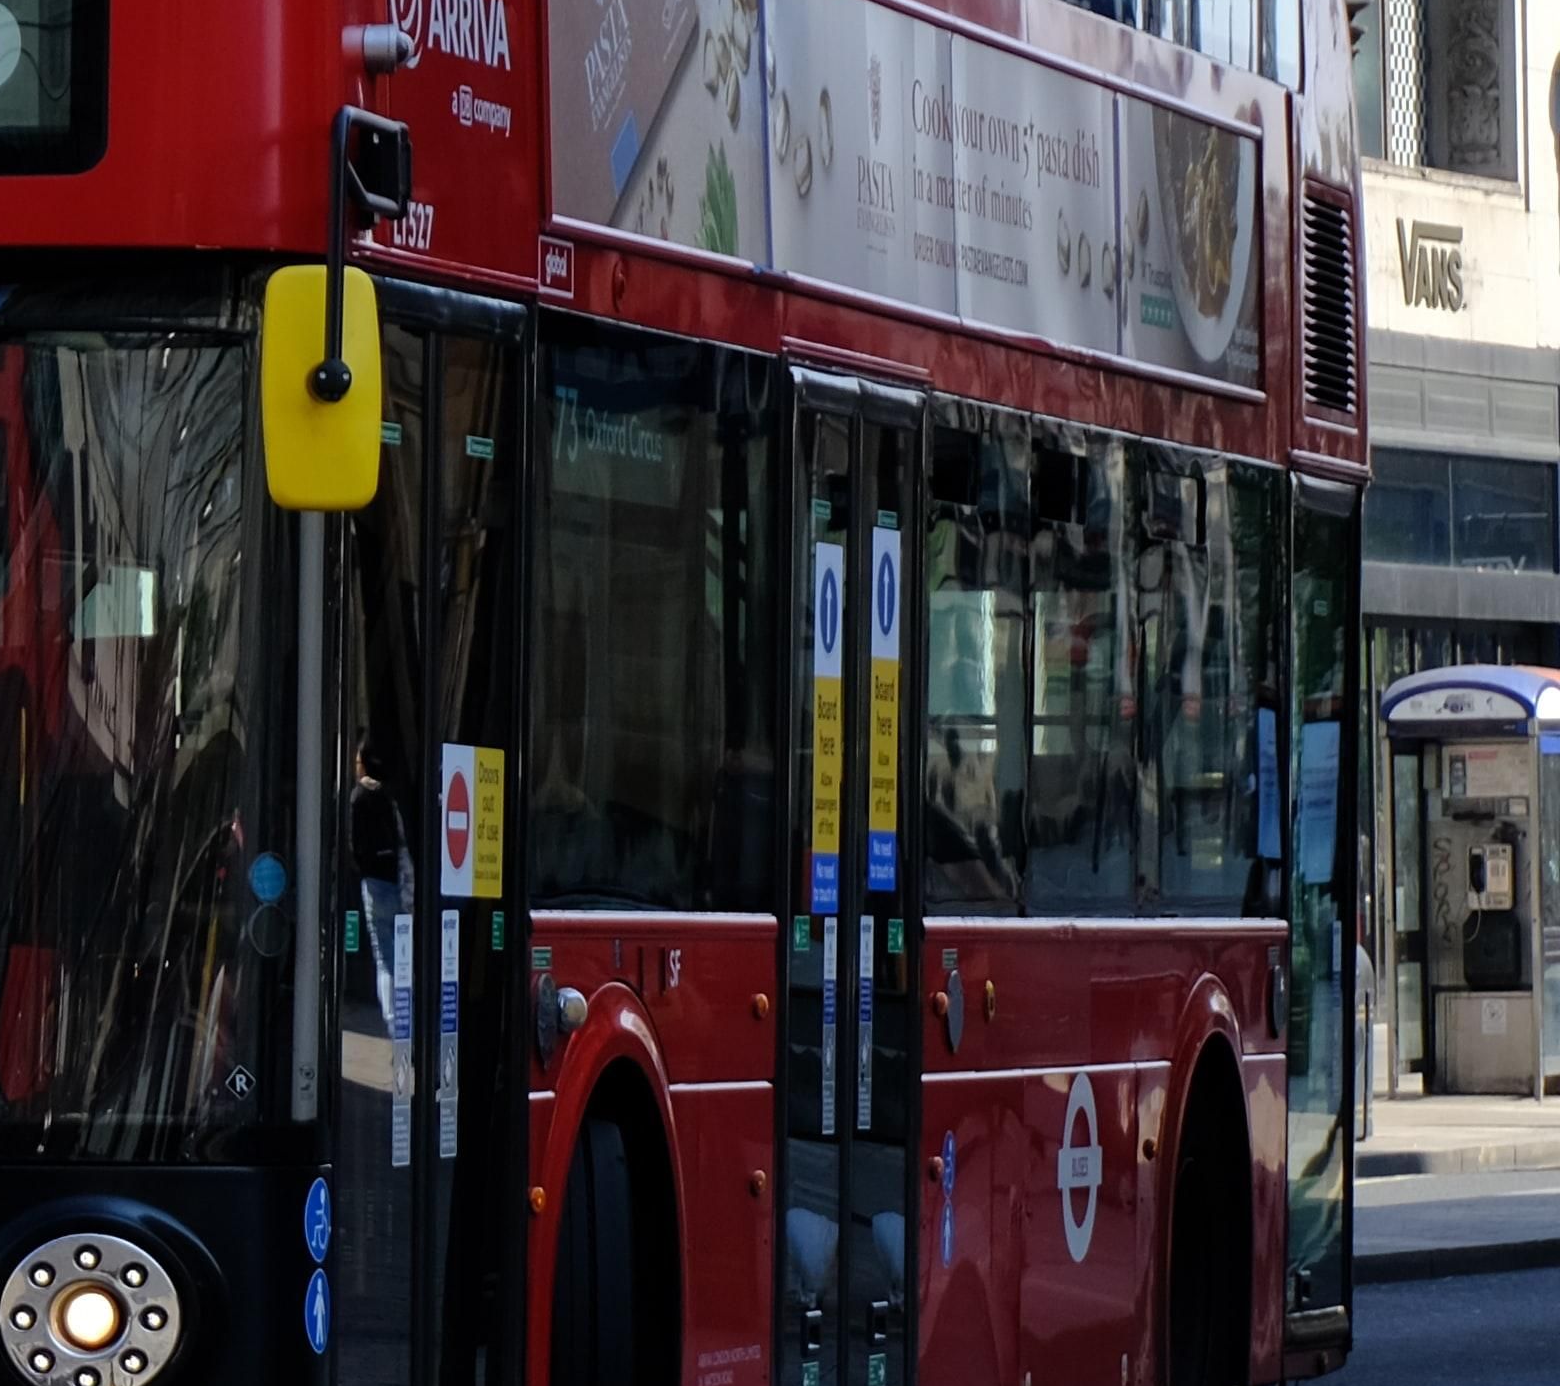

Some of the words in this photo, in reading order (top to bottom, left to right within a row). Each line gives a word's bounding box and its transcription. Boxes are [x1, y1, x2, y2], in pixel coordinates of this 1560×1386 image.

[473, 97, 511, 139] company
[912, 79, 952, 143] Cook
[953, 102, 985, 160] your
[988, 117, 1020, 164] own
[1036, 129, 1070, 188] pasta
[1072, 127, 1100, 189] dish
[857, 155, 895, 214] PASTA
[912, 153, 924, 201] in
[926, 171, 933, 203] a
[936, 174, 972, 215] mater
[975, 174, 988, 219] of
[991, 180, 1033, 231] minutes
[1396, 218, 1465, 311] VANS
[554, 384, 578, 463] 73
[584, 406, 627, 456] Oxford
[629, 414, 664, 462] Circus
[875, 675, 895, 703] Board
[818, 694, 838, 722] Board
[876, 710, 892, 737] here
[819, 728, 835, 756] here
[478, 761, 500, 785] Doors
[482, 795, 495, 813] out
[477, 818, 486, 840] of
[487, 824, 499, 842] use
[669, 949, 681, 987] SF
[235, 1074, 249, 1092] R
